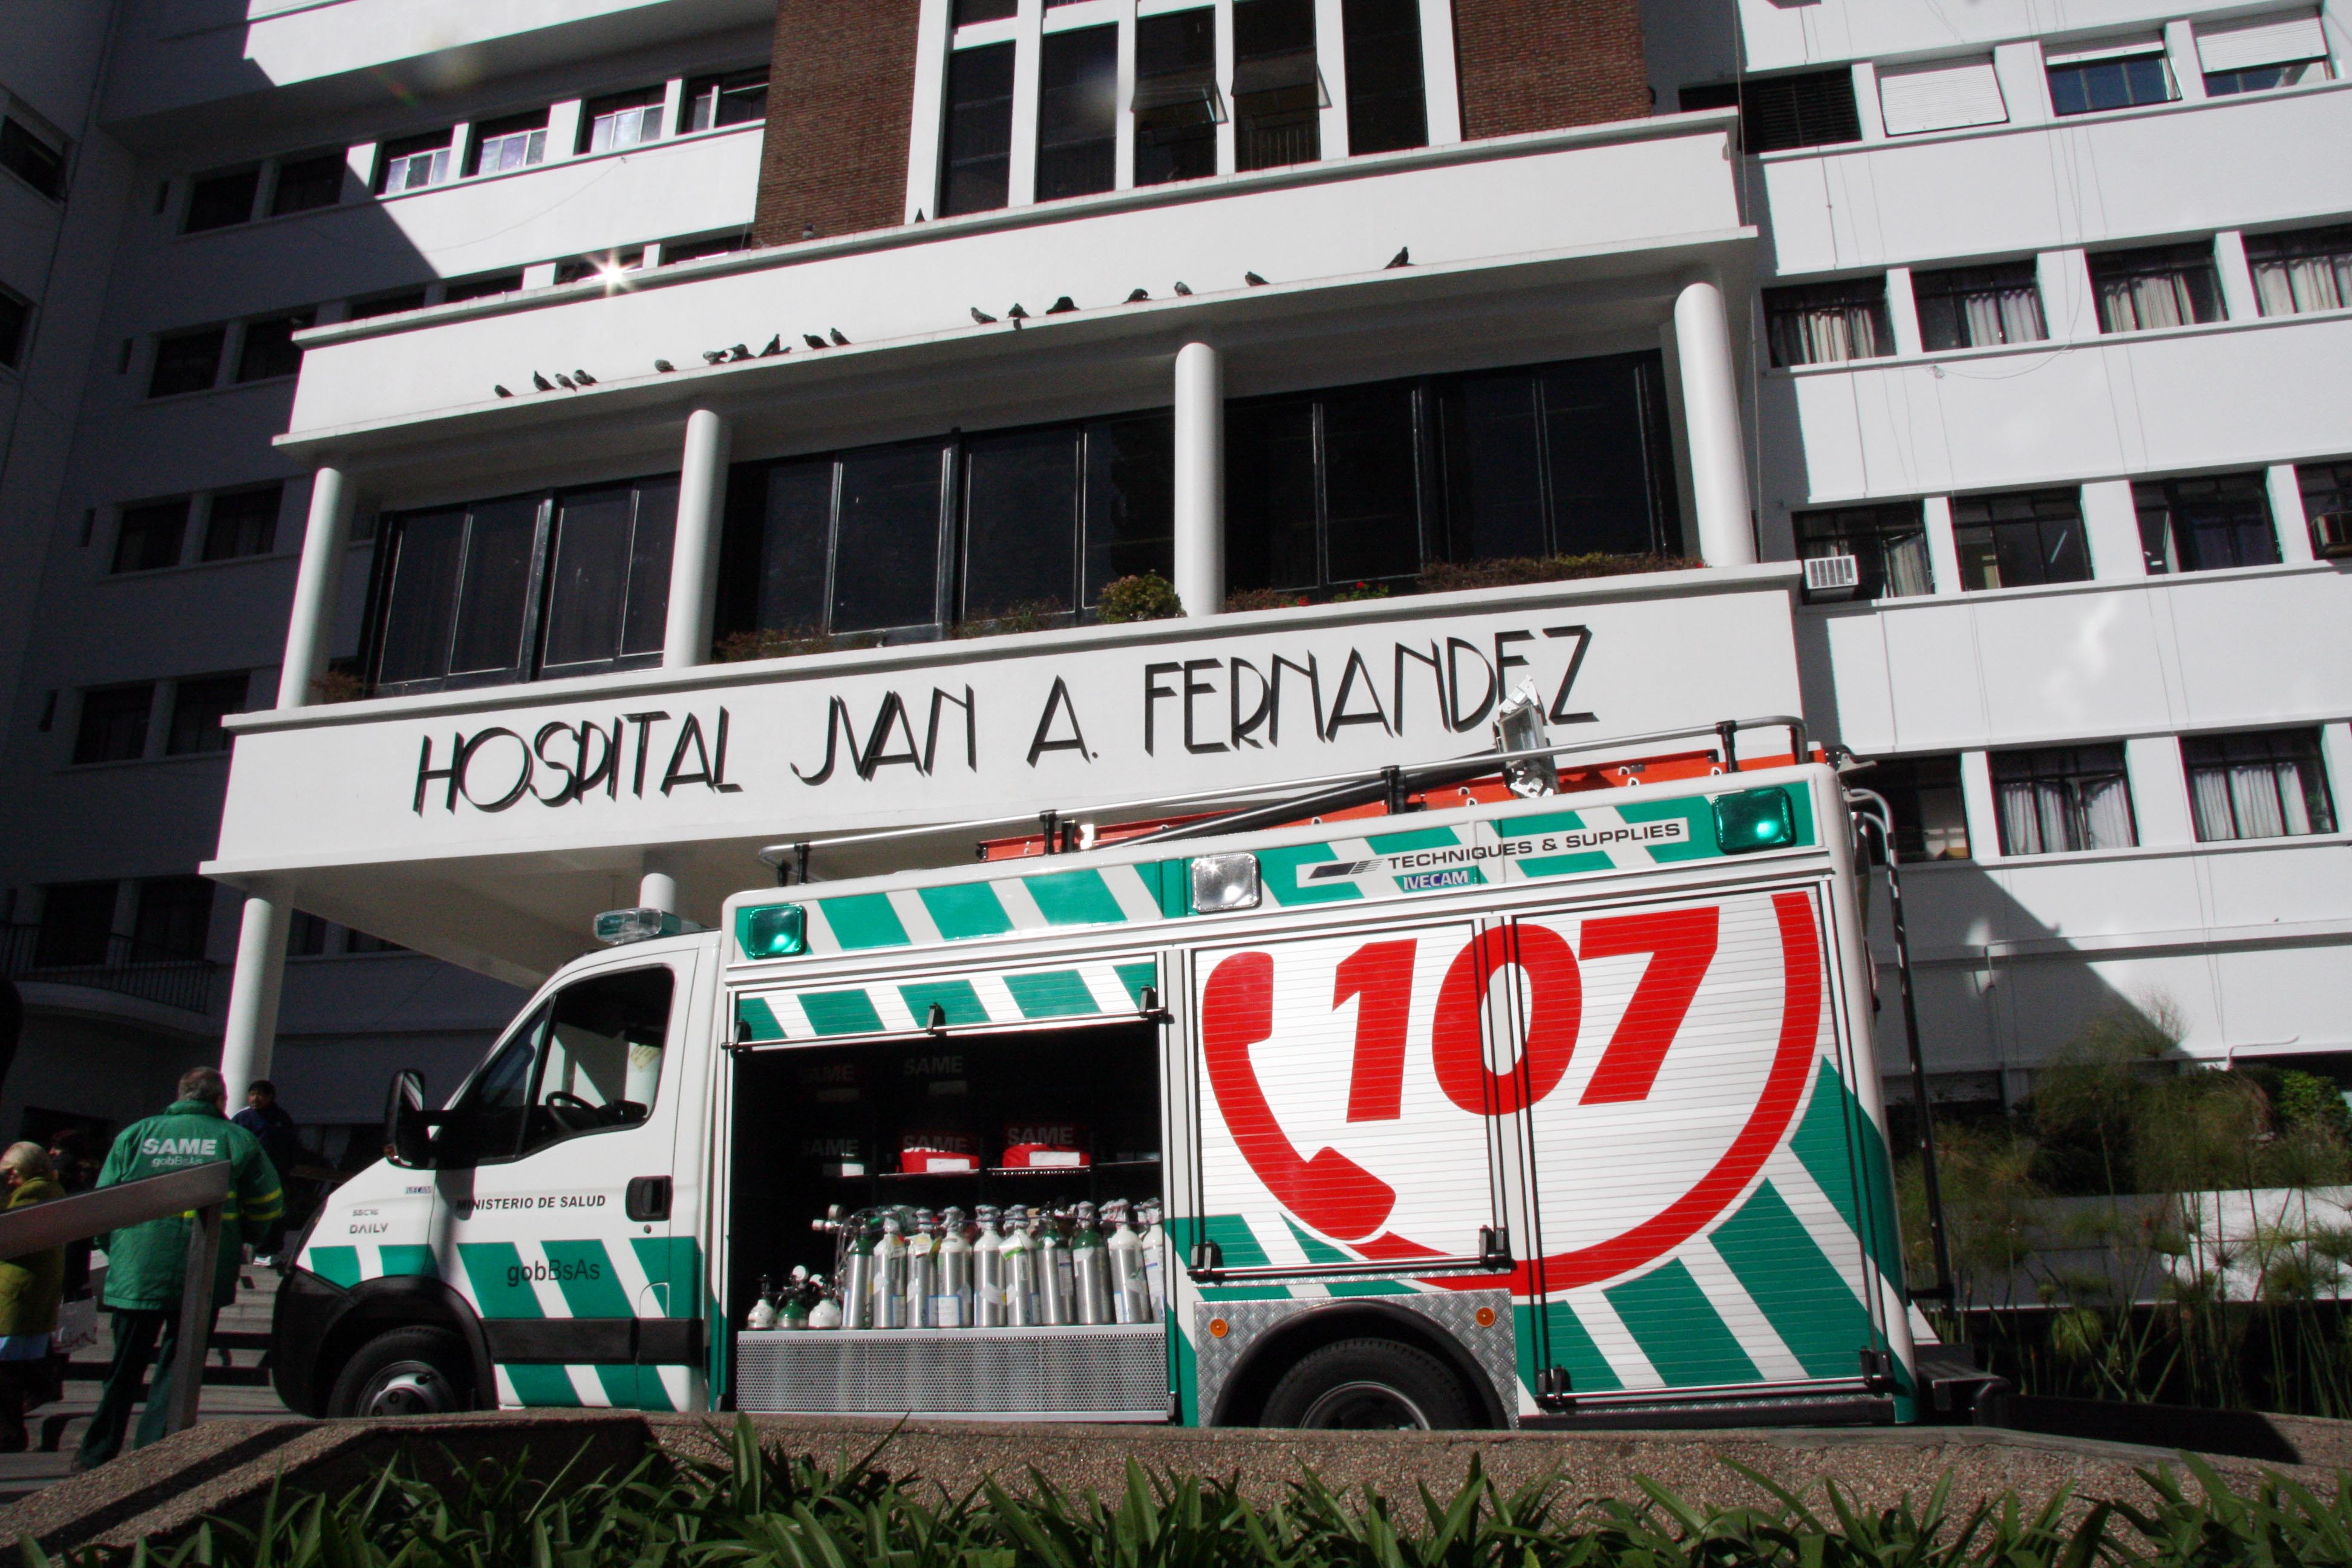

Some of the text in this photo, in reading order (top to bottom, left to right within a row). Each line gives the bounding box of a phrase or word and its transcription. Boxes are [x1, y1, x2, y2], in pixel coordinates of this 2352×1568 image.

[413, 705, 743, 818] HOSPITAL
[1026, 675, 1098, 768] A.
[1144, 624, 1599, 757] FERNANDEZ
[1388, 823, 1681, 869] TECHNIQUES & SUPPLIES
[1403, 870, 1469, 890] IVECAM
[1332, 906, 1719, 1123] 107
[903, 1135, 969, 1152] SAME
[1007, 1125, 1074, 1145] SAME
[142, 1138, 217, 1155] SAME
[457, 1195, 606, 1210] MINISTERIO DE SALUD
[349, 1223, 388, 1234] DAILY
[507, 1258, 601, 1287] gobBsAs
